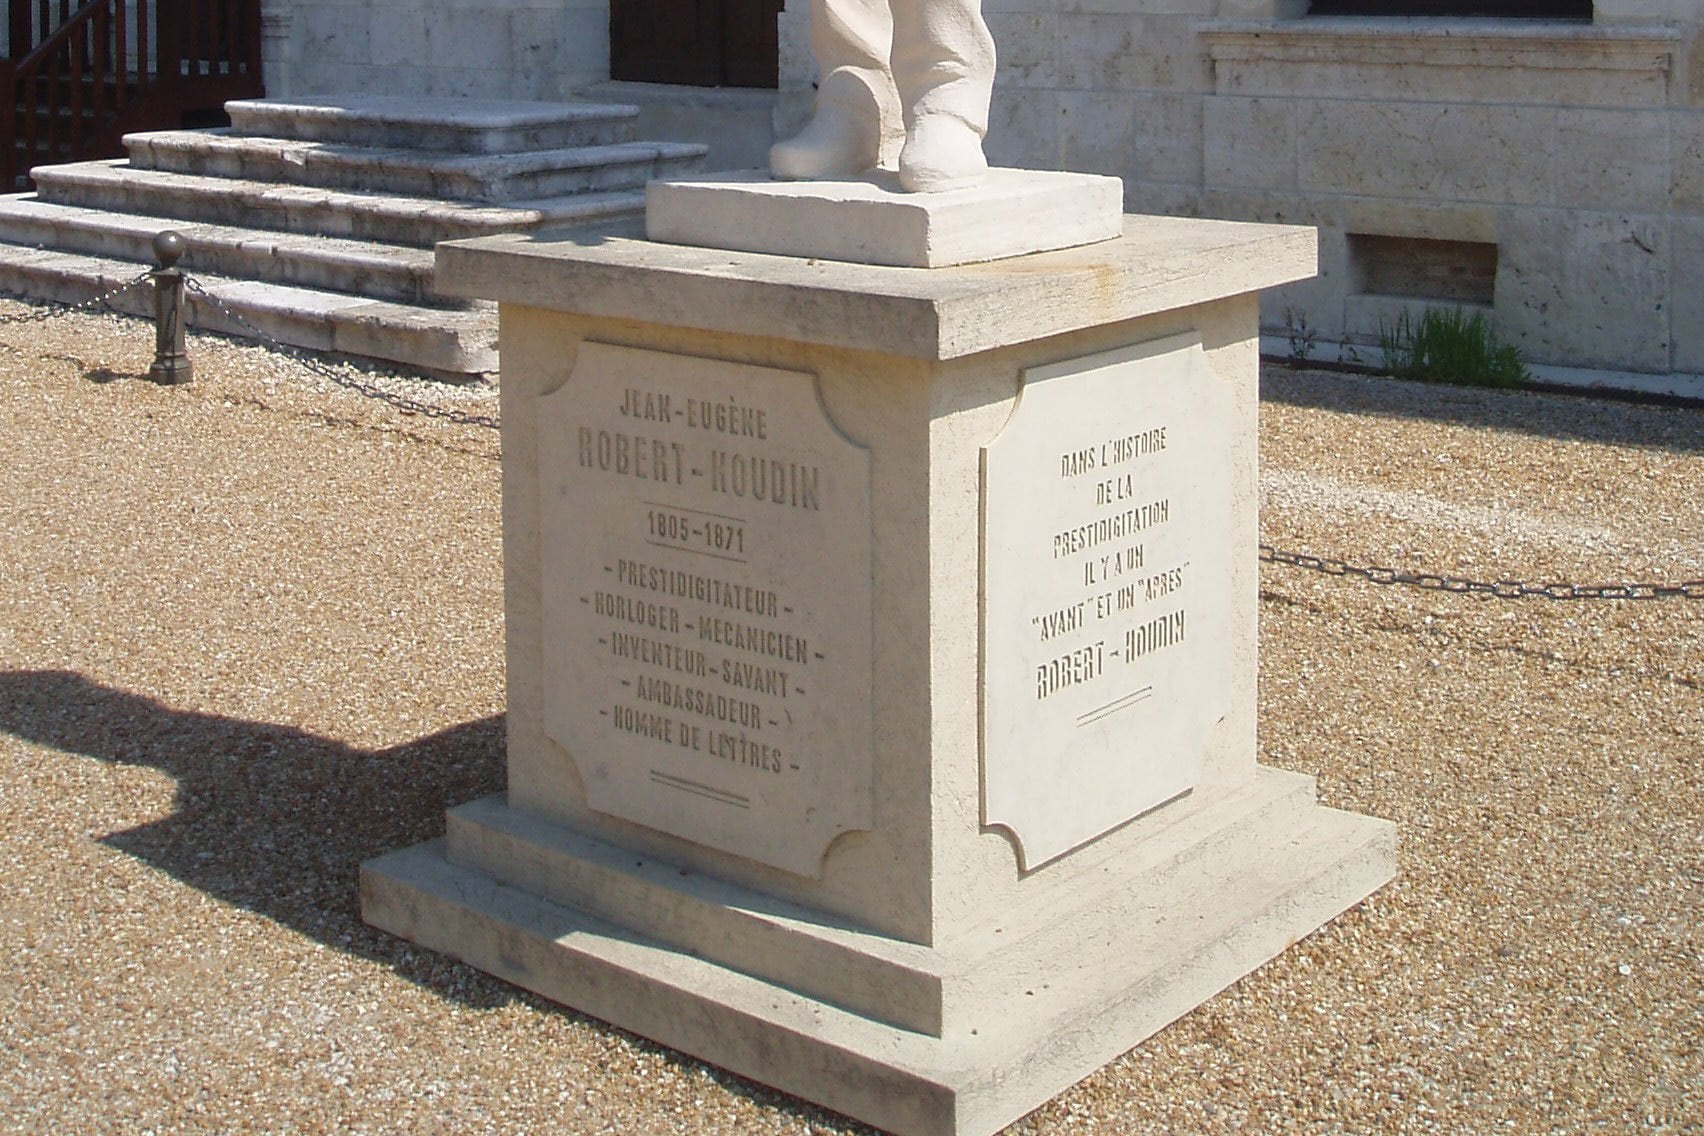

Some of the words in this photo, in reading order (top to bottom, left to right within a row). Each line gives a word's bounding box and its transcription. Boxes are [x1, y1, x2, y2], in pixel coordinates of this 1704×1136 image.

[620, 388, 767, 440] JEAN-EUGÈNE
[1061, 447, 1095, 479] DANS
[1101, 426, 1167, 467] L'HISTOIRE
[1096, 479, 1112, 505] DE
[1117, 474, 1133, 500] LA
[647, 511, 744, 553] 1805-1871
[1054, 499, 1169, 559] PRESTIDIGITATION
[618, 559, 777, 618] PRESTIDIGITATEUR
[1085, 562, 1096, 586] IL
[1101, 556, 1110, 581] Y
[1114, 551, 1122, 576] A
[1127, 544, 1144, 570] UN
[1097, 592, 1112, 619] ET
[1117, 584, 1135, 611] UN
[637, 675, 761, 729] AMBASSADEUR
[614, 704, 672, 744] HOMME
[680, 722, 700, 751] DE
[709, 730, 782, 774] LETTRES
